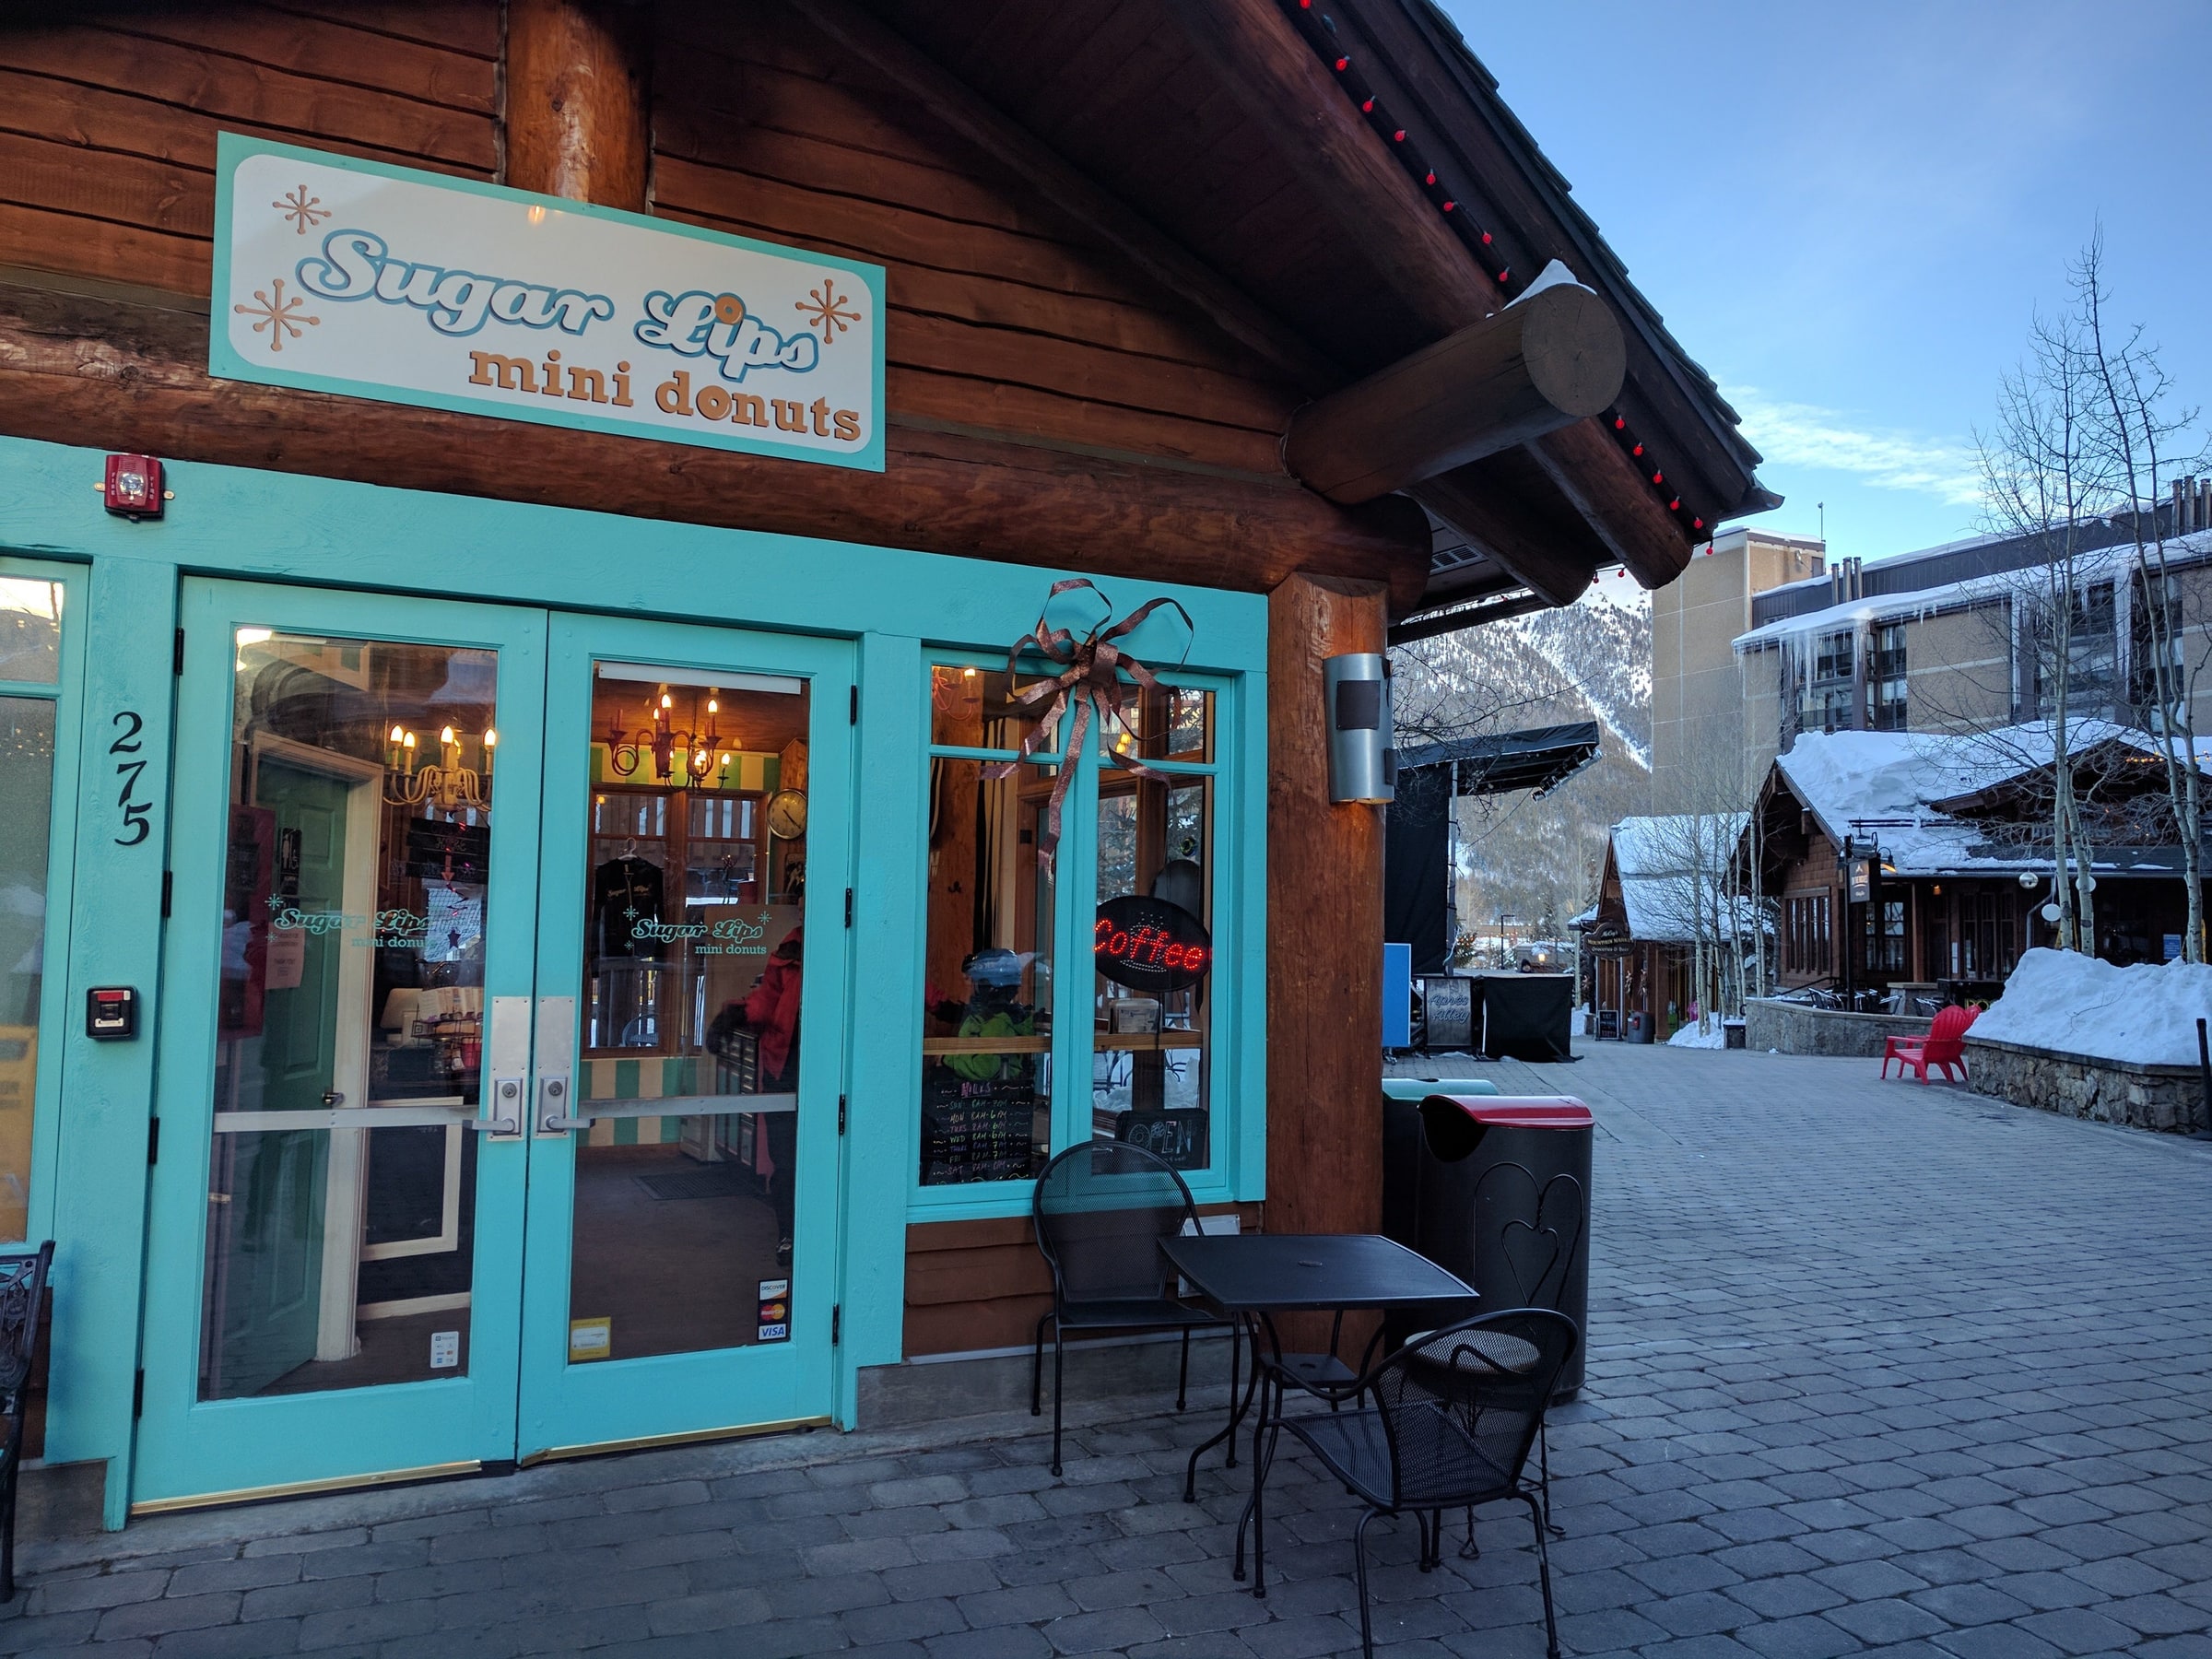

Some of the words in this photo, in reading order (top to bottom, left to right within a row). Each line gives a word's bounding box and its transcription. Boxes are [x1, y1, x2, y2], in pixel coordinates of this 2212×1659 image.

[295, 229, 615, 337] Sugar
[633, 290, 818, 383] Lips
[469, 349, 633, 407] mini
[655, 371, 861, 441] donuts
[109, 712, 153, 846] 275
[275, 908, 367, 935] Sugar
[372, 908, 434, 935] Lips
[631, 919, 708, 944] Sugar
[712, 919, 763, 944] Lips
[352, 936, 383, 947] mini
[695, 944, 723, 955] mini
[726, 944, 767, 955] donuts
[1093, 919, 1204, 970] Coffee
[762, 1326, 785, 1337] VISA
